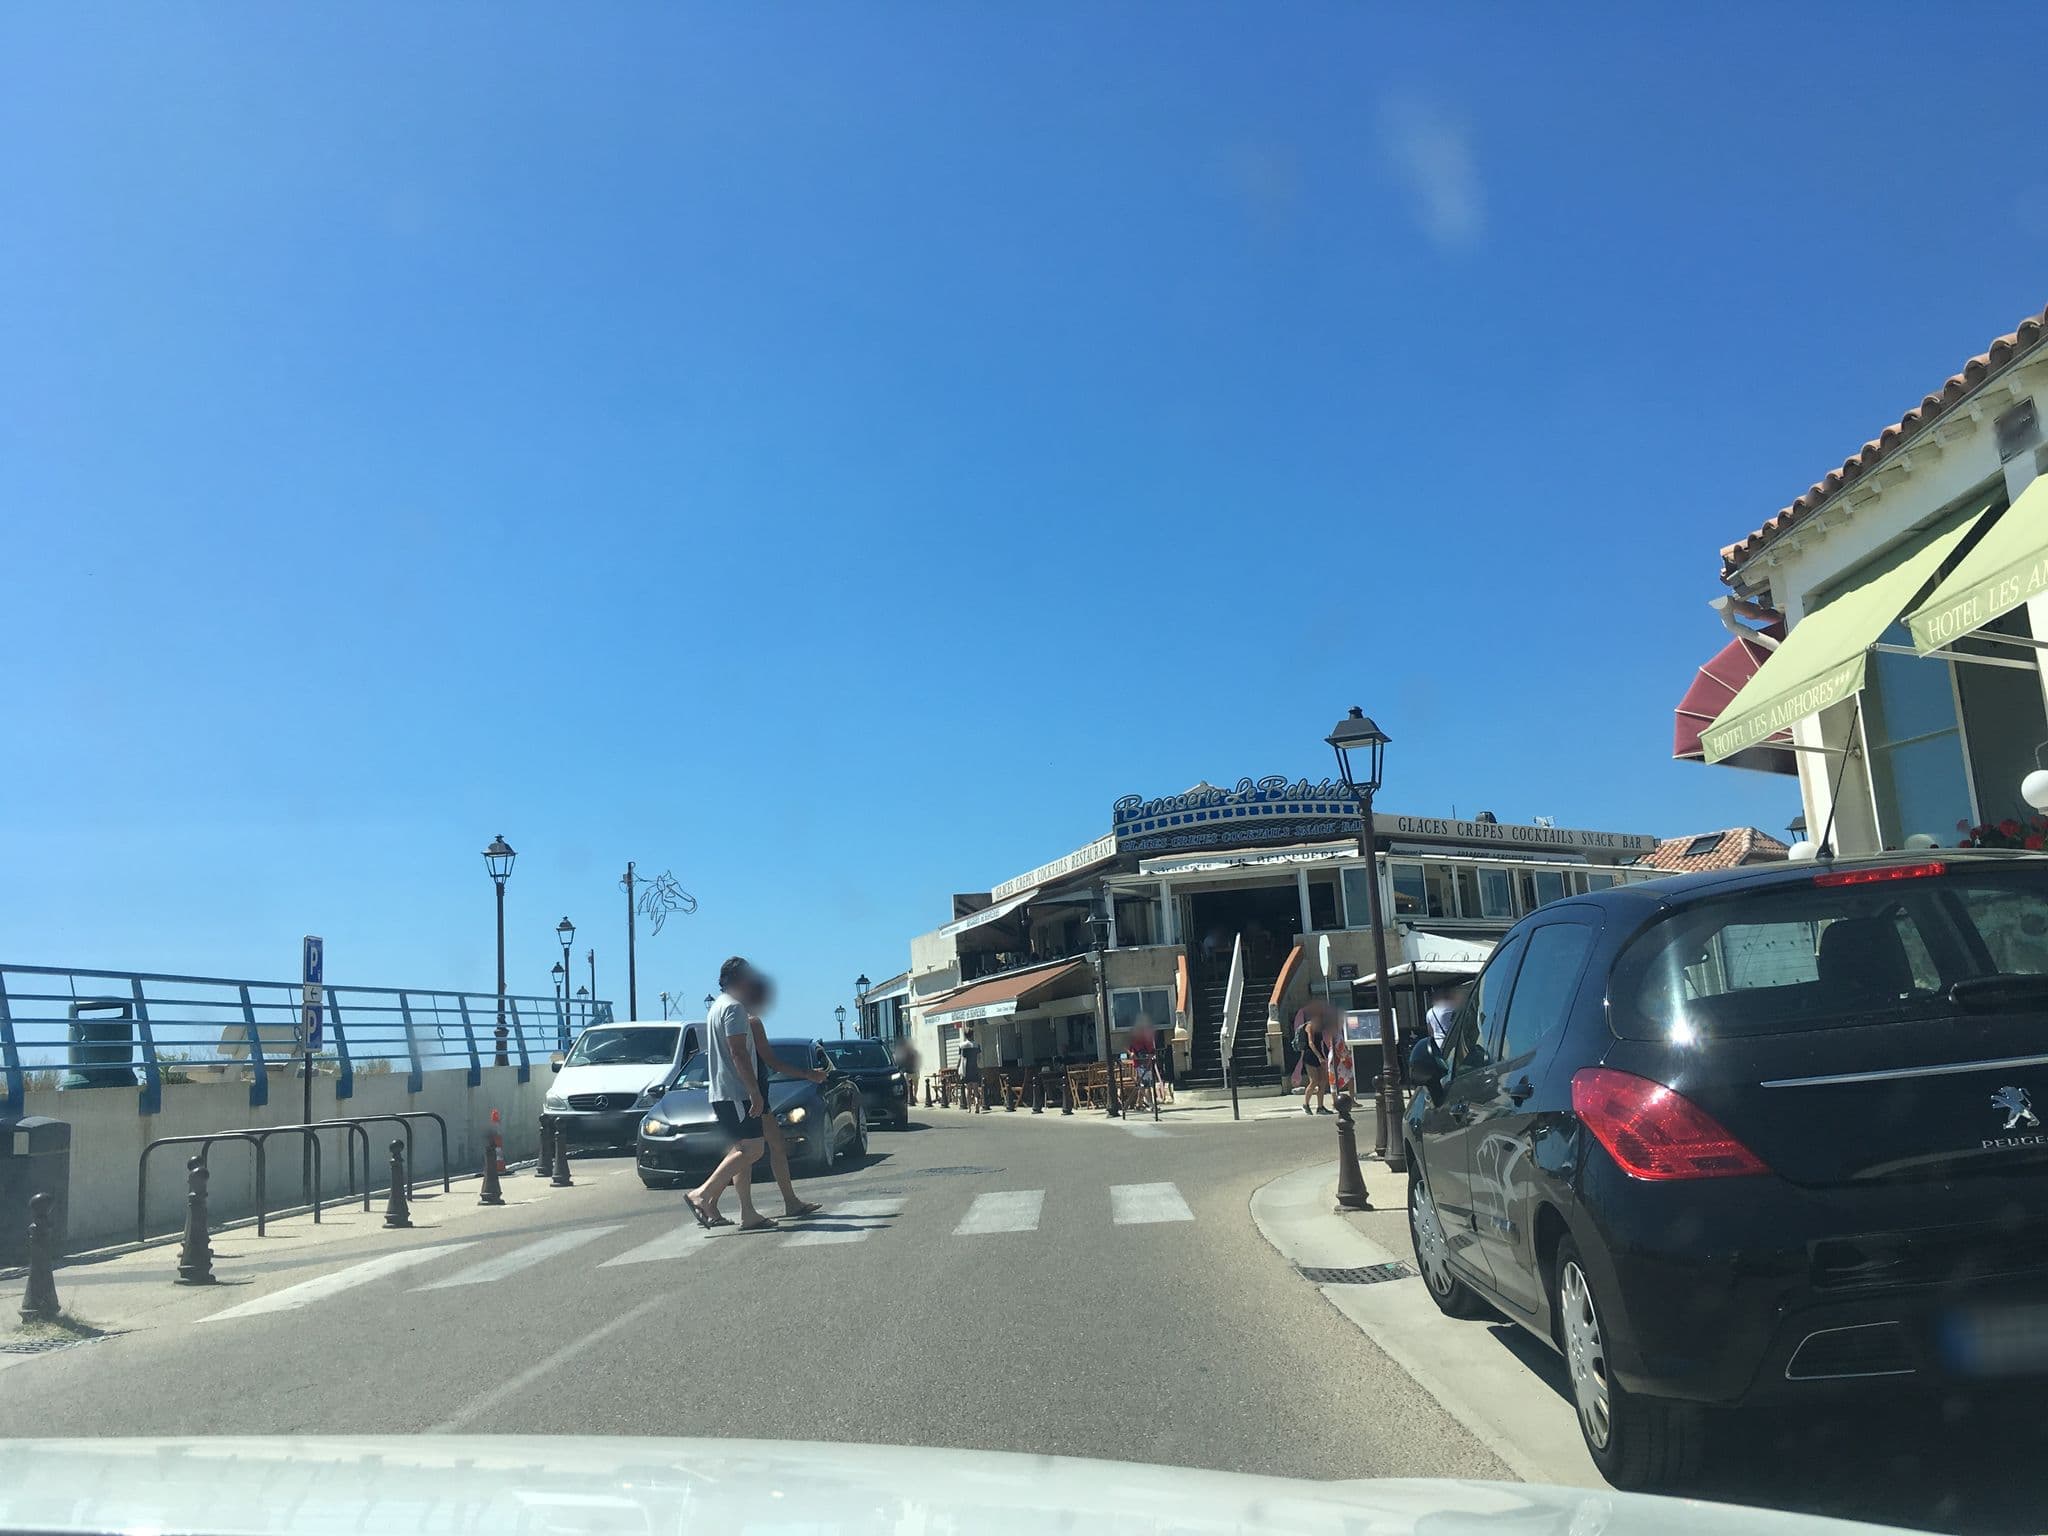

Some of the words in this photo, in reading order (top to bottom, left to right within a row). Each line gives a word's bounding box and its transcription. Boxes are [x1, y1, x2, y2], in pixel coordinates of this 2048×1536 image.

[1927, 597, 1982, 644] HOTEL
[1989, 575, 2019, 612] LES
[1713, 728, 1747, 755] HOTEL
[1749, 713, 1767, 739] LES
[1770, 679, 1834, 730] AMPHORES
[1113, 788, 1220, 821] Brasserie
[1224, 776, 1257, 804] Le
[1398, 816, 1448, 835] GLACES
[1457, 822, 1504, 840] CREPES
[1512, 827, 1574, 845] COCKTAILS
[1581, 831, 1615, 848] SNACK
[1622, 836, 1642, 849] BAR
[1037, 859, 1068, 882] COCKTAILS
[1072, 839, 1113, 869] RESTAURANT
[310, 946, 318, 975] P
[307, 1010, 317, 1043] P
[1981, 1135, 2048, 1149] PEUGE
